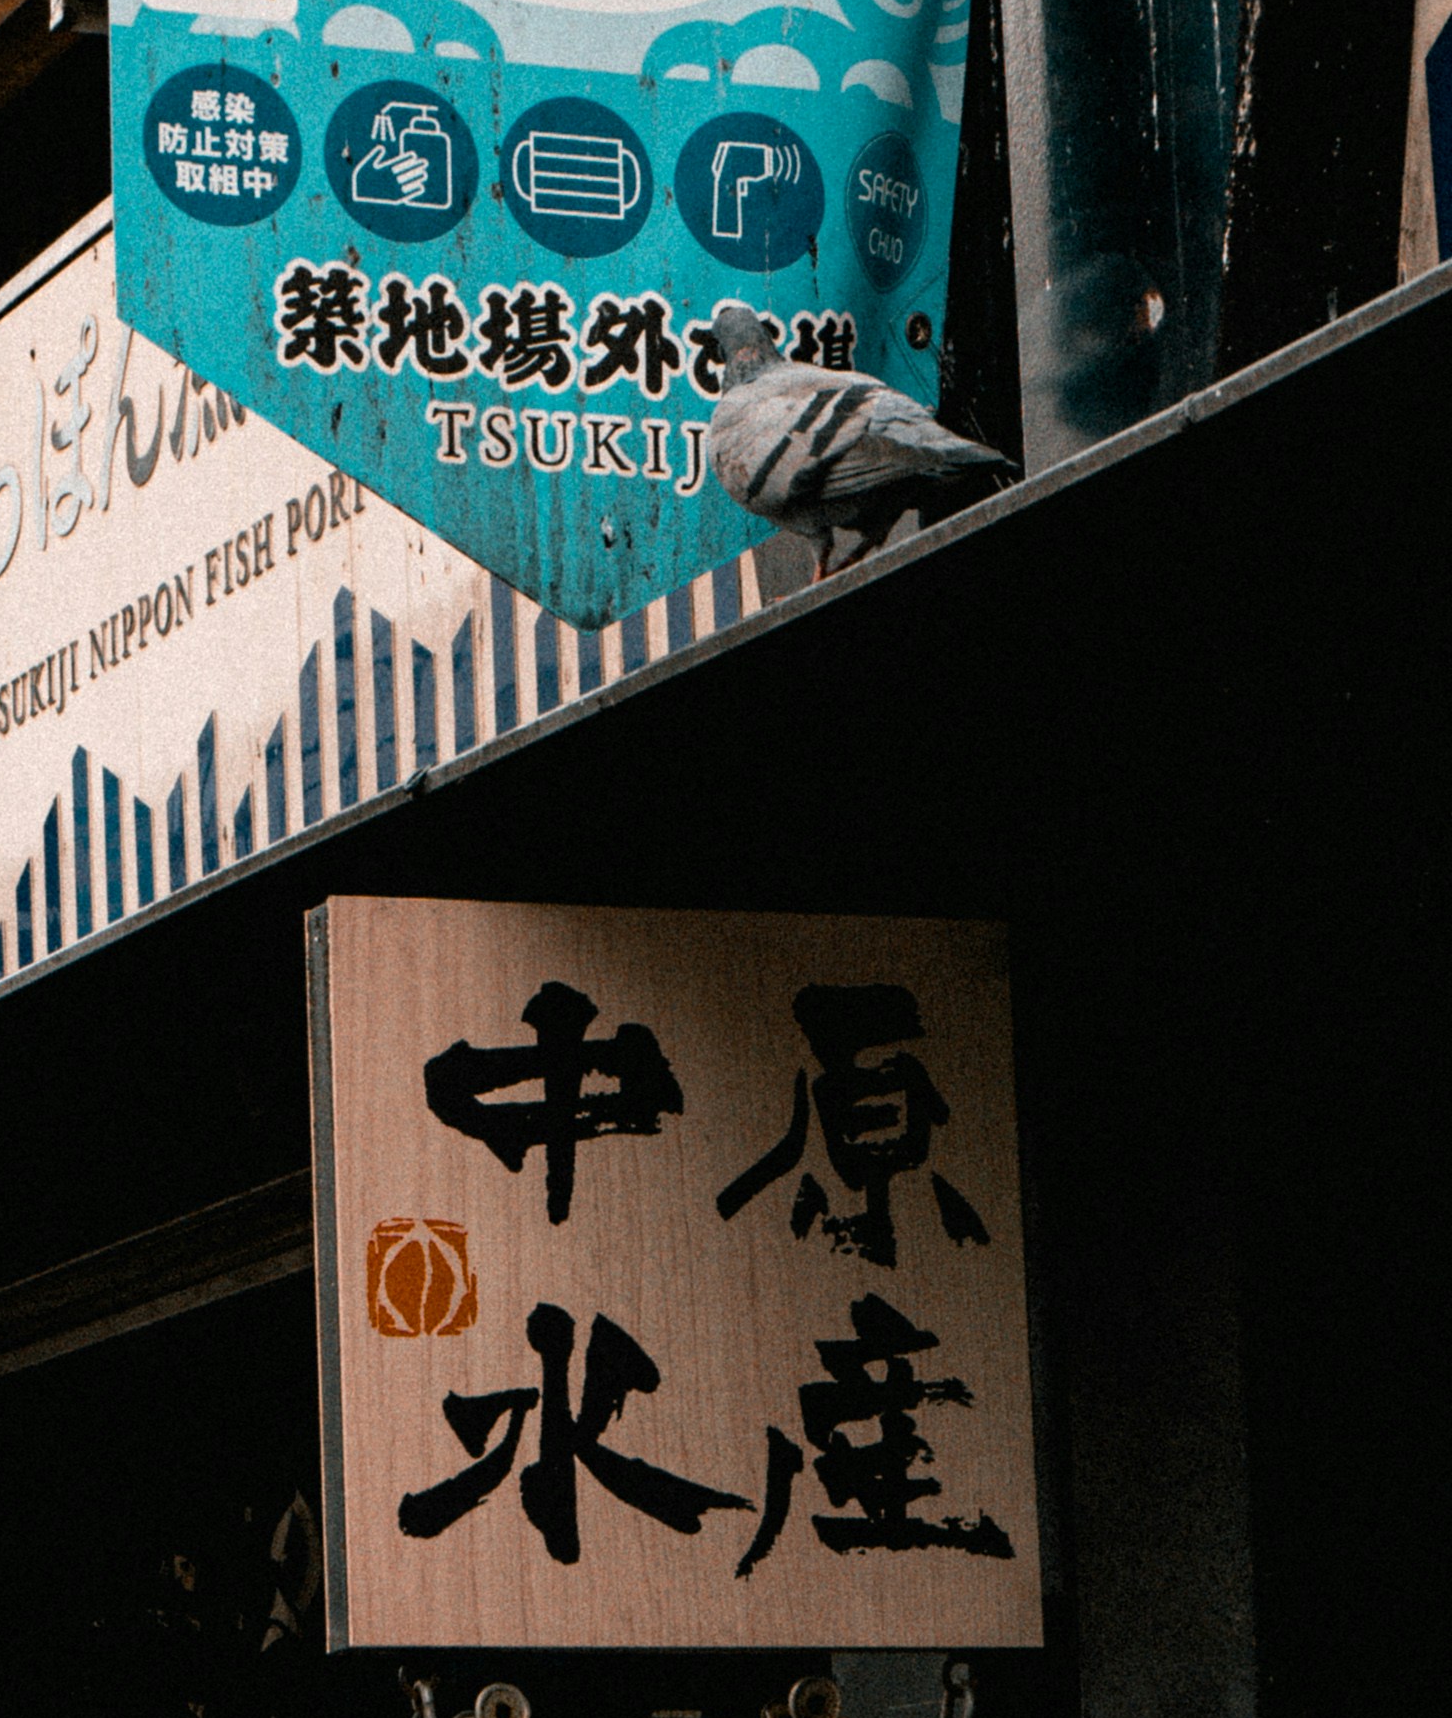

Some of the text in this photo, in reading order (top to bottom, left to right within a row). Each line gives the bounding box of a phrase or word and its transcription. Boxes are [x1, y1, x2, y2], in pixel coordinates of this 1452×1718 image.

[189, 90, 256, 125] 感染
[156, 121, 290, 166] 防止対策
[174, 160, 274, 199] 取組中
[857, 167, 920, 217] SAFETY
[867, 229, 905, 267] CHUO
[429, 403, 711, 495] TSUKIJ
[87, 573, 197, 684] NIPPON
[204, 515, 276, 610] FISH
[285, 470, 366, 560] PORT
[423, 981, 992, 1270] 中原
[398, 1291, 1016, 1580] 水産
